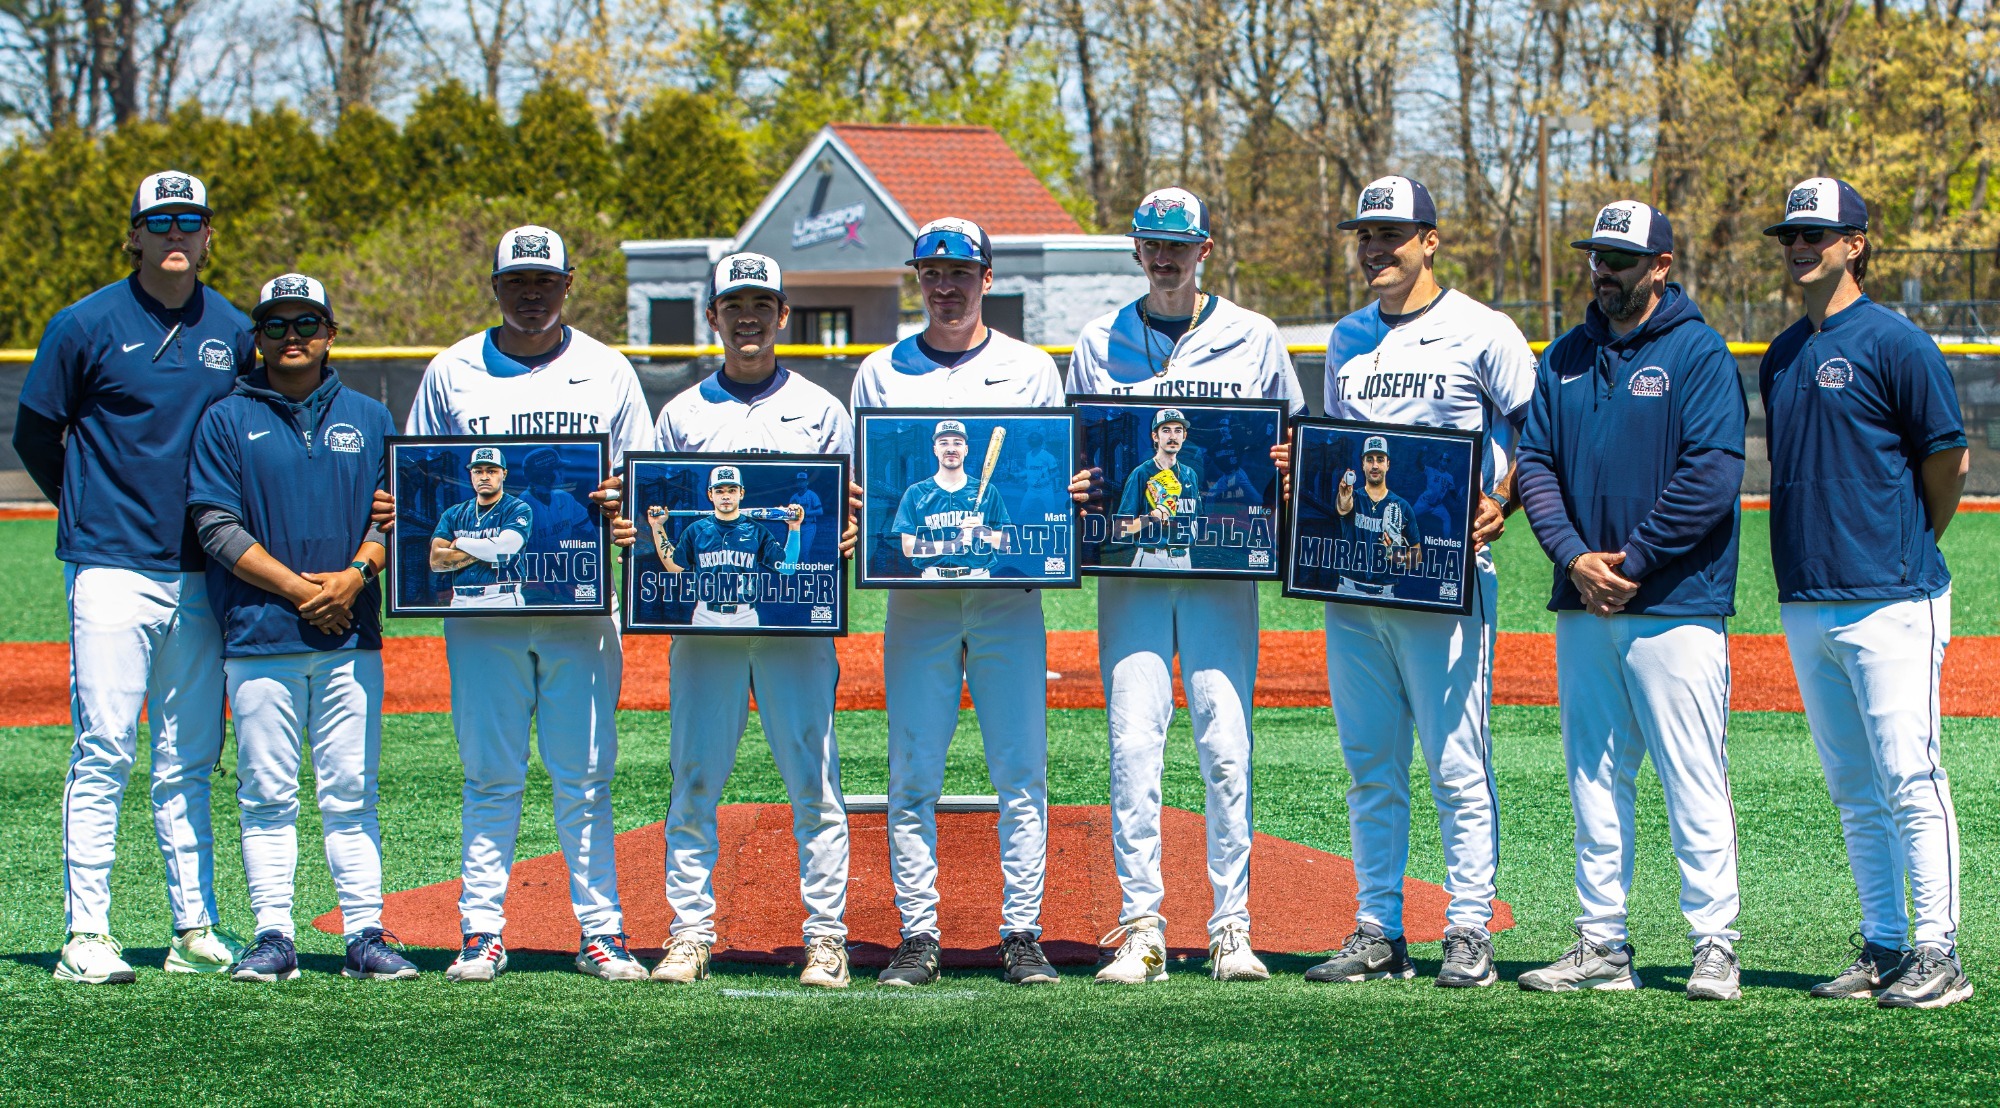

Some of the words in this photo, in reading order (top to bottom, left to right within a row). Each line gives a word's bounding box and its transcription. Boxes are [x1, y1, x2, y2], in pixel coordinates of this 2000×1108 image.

[1358, 373, 1446, 400] JOSEPH'S
[1044, 512, 1067, 522] Matt
[1248, 505, 1272, 516] Mike
[912, 524, 1067, 556] ARCATI
[1082, 513, 1272, 549] DEDELLA
[1424, 535, 1462, 548] Nicholas
[559, 539, 597, 549] William
[496, 551, 597, 583] KING
[699, 550, 755, 569] BROOKLYN
[774, 561, 834, 572] Christopher
[1299, 535, 1461, 582] MIRABELLA
[640, 570, 835, 604] STEGMULLER
